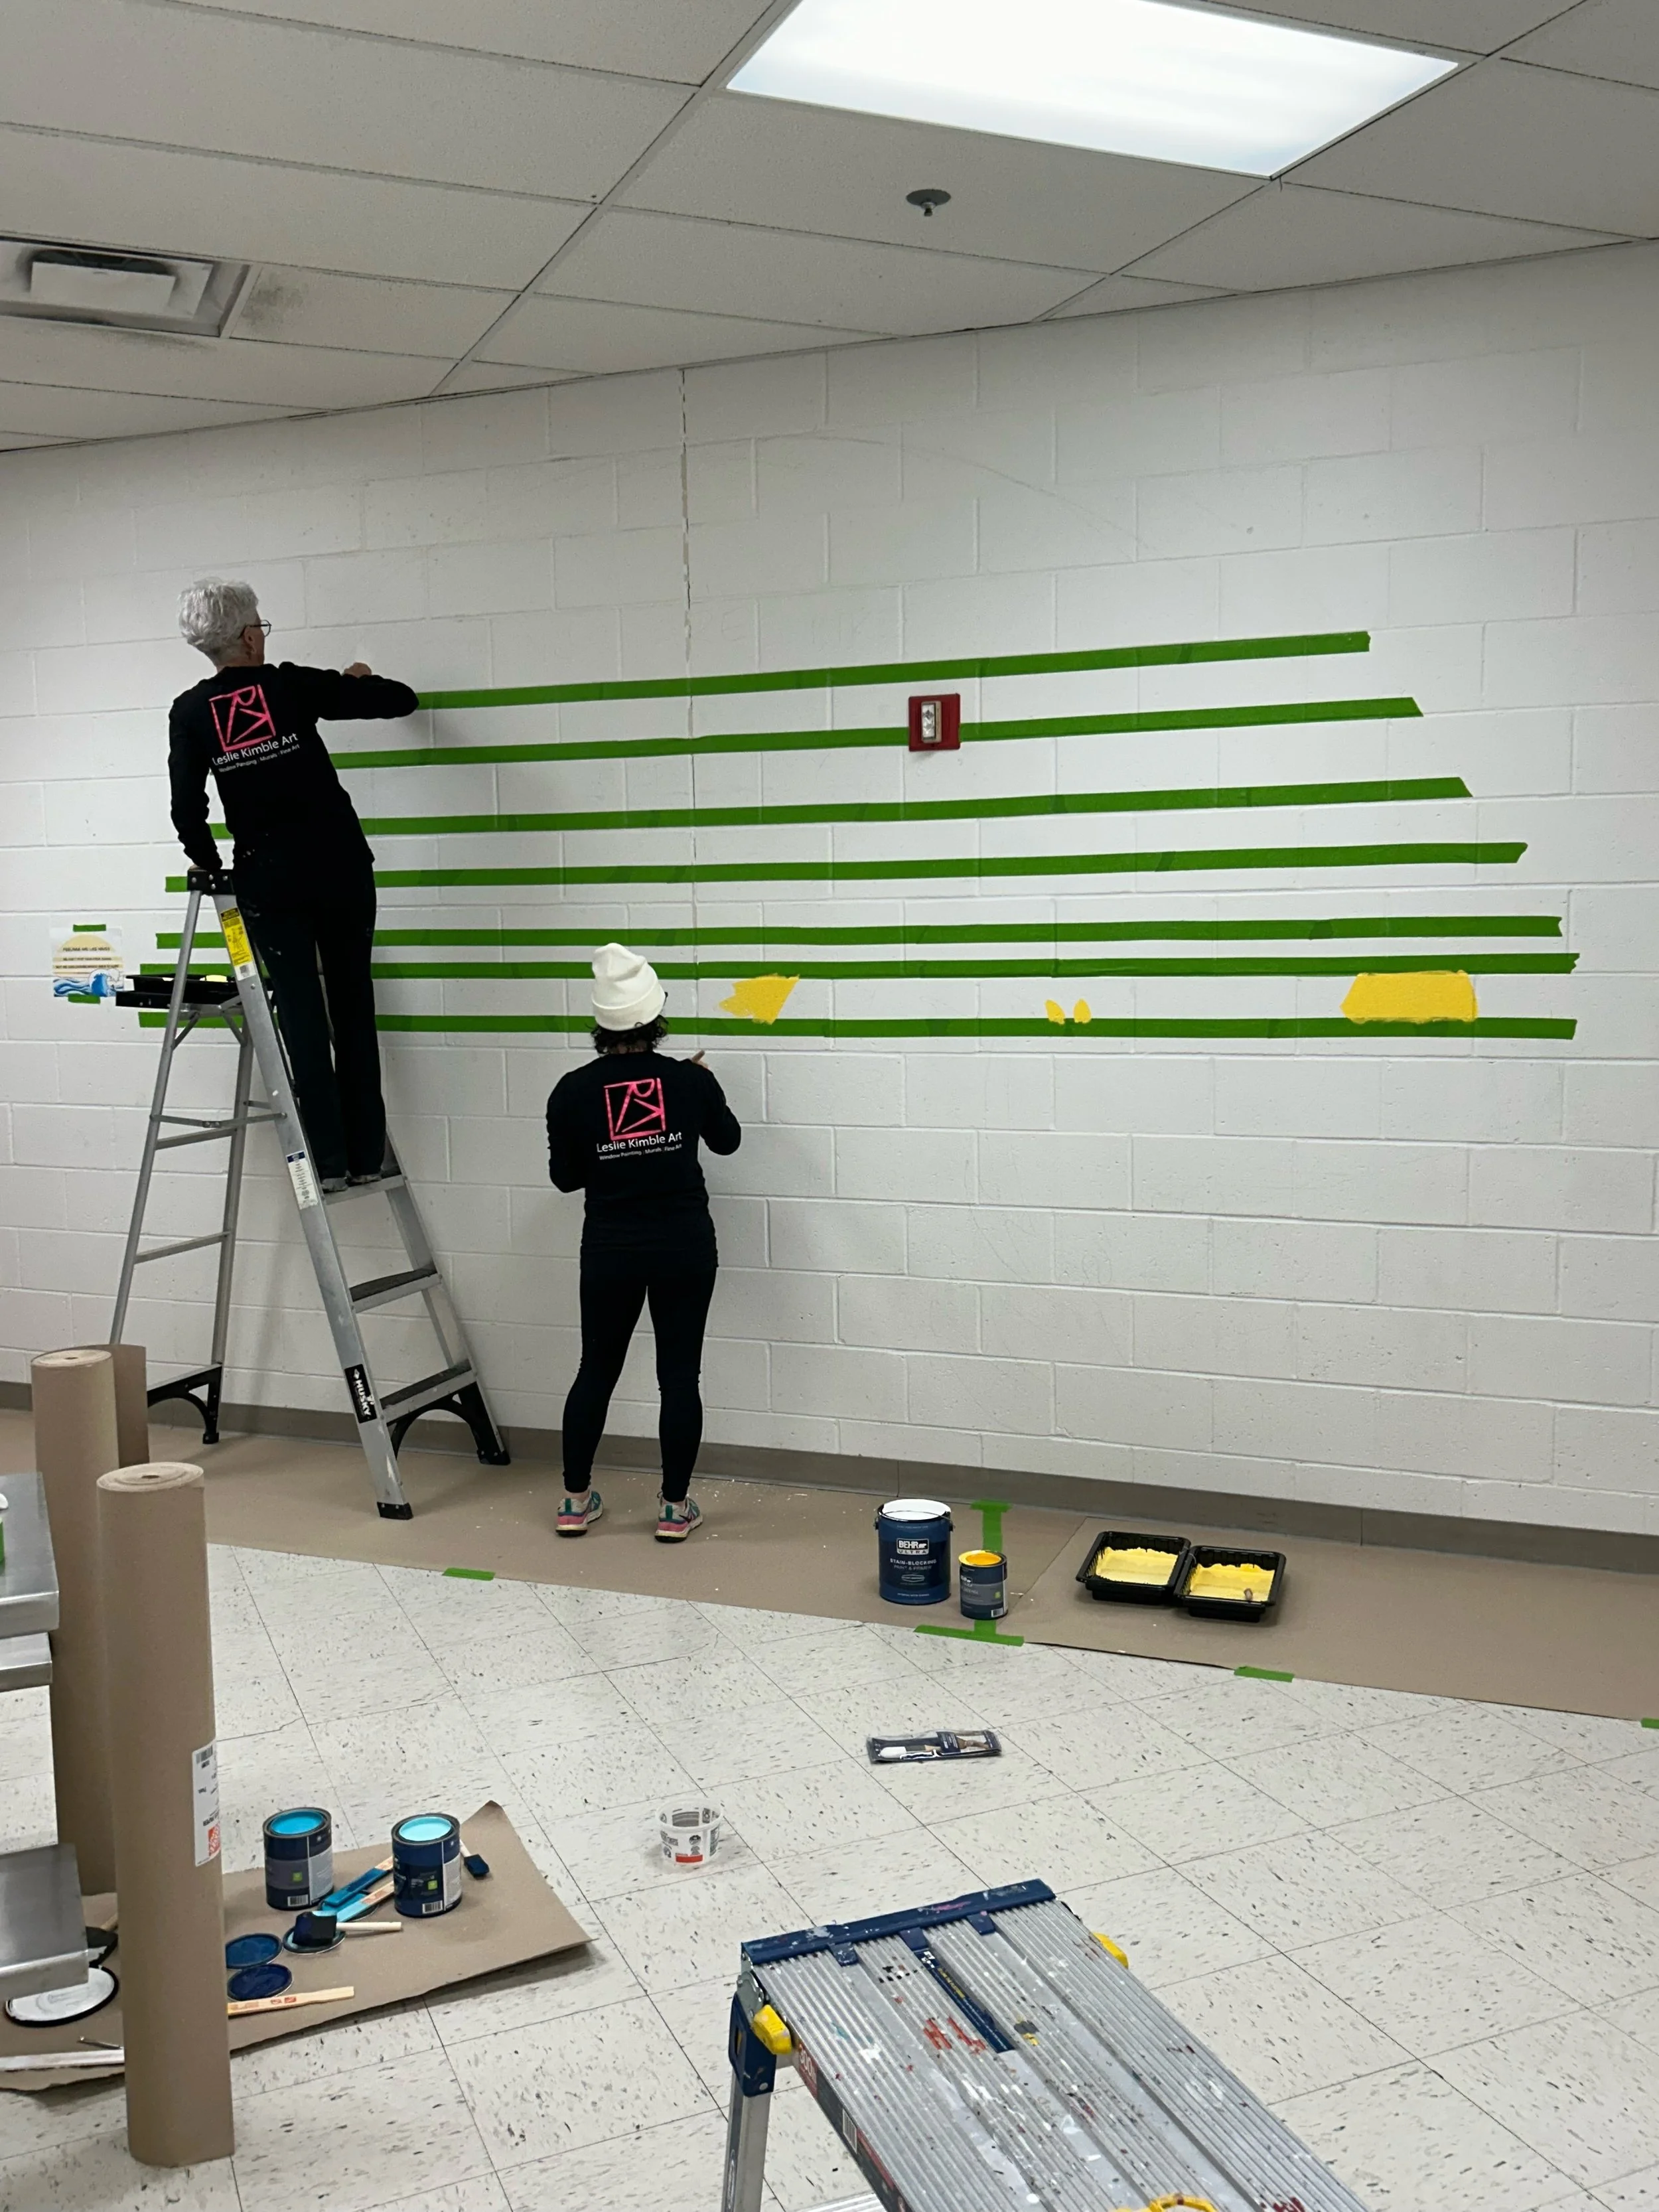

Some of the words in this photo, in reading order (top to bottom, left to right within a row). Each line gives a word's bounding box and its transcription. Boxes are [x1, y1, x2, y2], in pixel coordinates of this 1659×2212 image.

[212, 752, 240, 766] Leslie
[240, 741, 279, 758] Kimble
[281, 733, 299, 746] Art
[597, 1141, 626, 1153] Leslie
[628, 1135, 666, 1148] Kimble
[668, 1132, 682, 1143] Art
[599, 1152, 620, 1161] Window
[899, 1540, 918, 1549] BEHR
